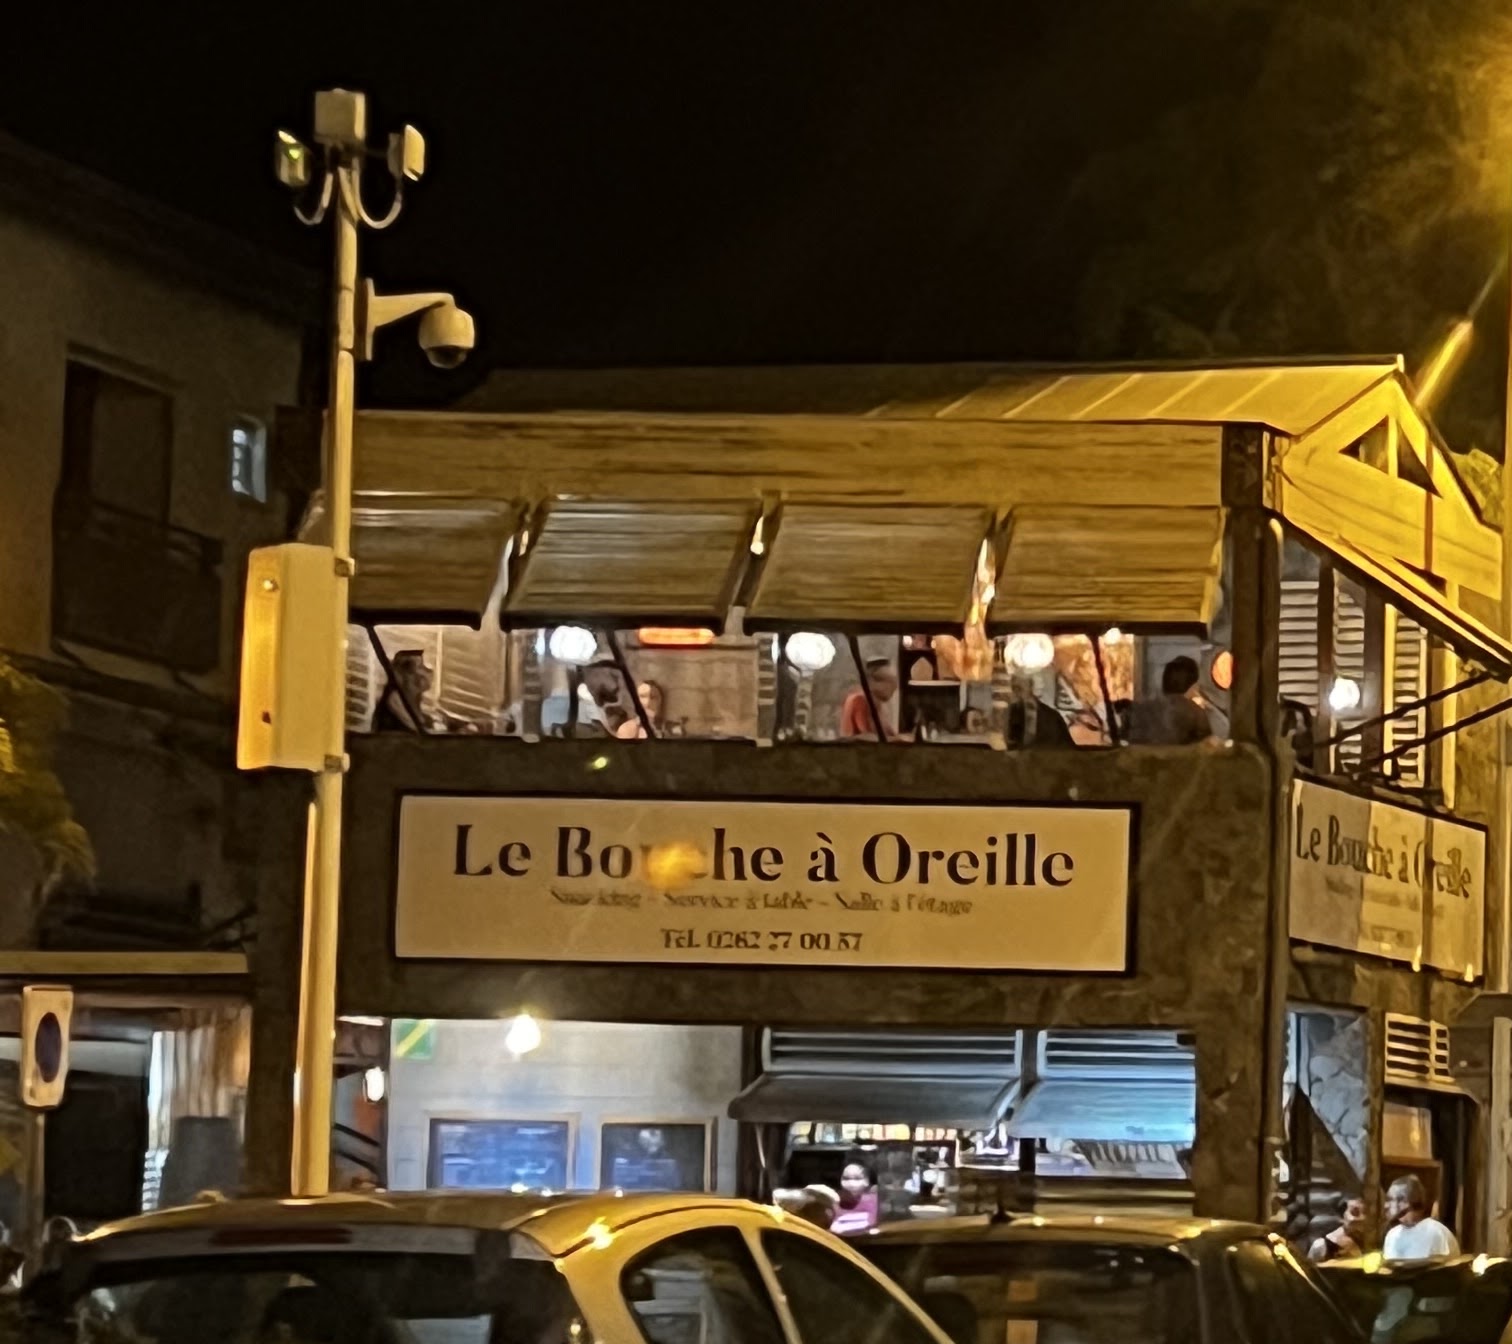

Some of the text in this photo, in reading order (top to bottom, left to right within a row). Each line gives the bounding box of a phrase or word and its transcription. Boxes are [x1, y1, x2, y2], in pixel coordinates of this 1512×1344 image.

[453, 824, 1075, 887] Le Bohe à Oreille
[1296, 802, 1321, 863] Le
[799, 932, 832, 951] 00
